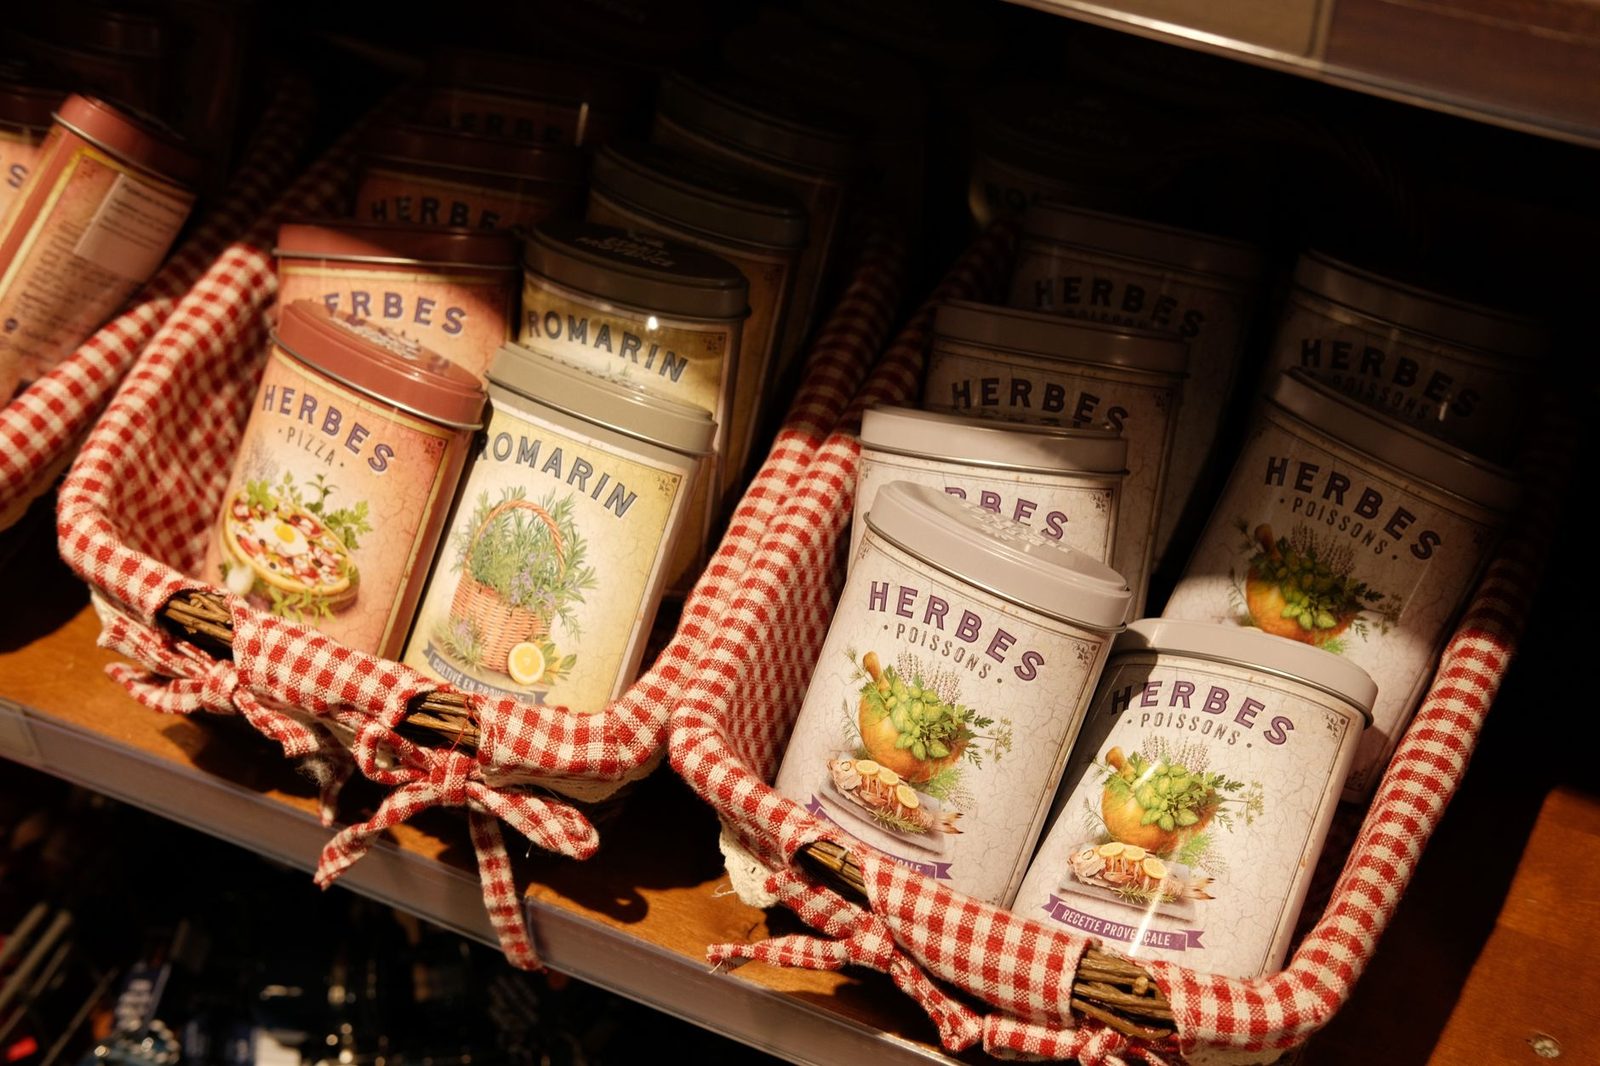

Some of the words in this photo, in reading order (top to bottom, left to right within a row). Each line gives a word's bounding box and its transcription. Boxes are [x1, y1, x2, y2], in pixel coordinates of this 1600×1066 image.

[372, 197, 501, 231] HERBE
[1034, 276, 1204, 337] HERBES
[526, 310, 688, 383] ROMARIN
[951, 377, 1129, 433] HERBES
[1301, 339, 1480, 418] HERBES
[262, 385, 395, 473] HERBES
[285, 426, 336, 467] PIZZA
[477, 431, 638, 519] OMARIN
[1264, 456, 1442, 560] HERBES
[1292, 497, 1388, 555] POISSONS
[868, 580, 1045, 682] HERBES
[896, 622, 992, 679] POISSONS
[462, 681, 476, 693] EN
[1110, 680, 1295, 746] HERBES
[1140, 711, 1241, 747] POISSONS
[1061, 908, 1104, 934] RECETTE
[1102, 923, 1172, 946] PROVEÇALE
